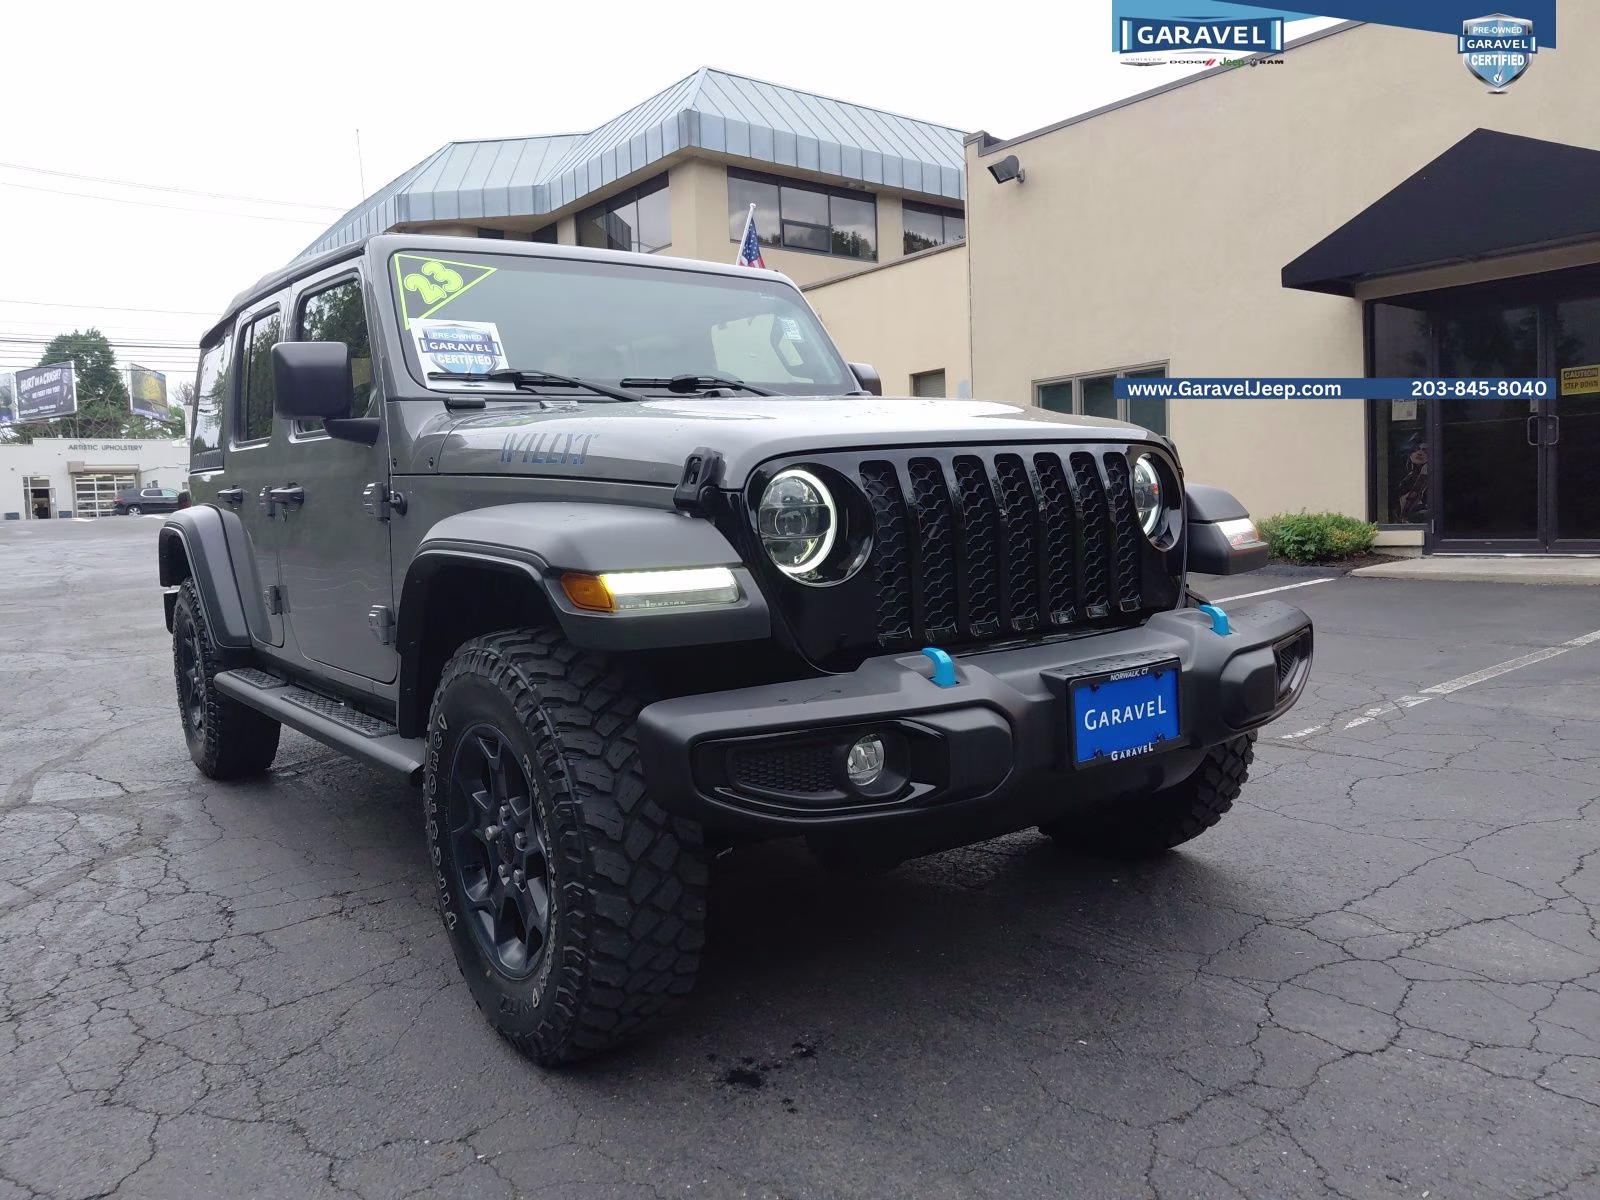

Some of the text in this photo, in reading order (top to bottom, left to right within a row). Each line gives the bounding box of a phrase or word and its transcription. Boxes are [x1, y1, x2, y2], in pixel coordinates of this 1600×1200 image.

[404, 261, 464, 305] 23
[432, 332, 483, 341] PRE-OWNED
[429, 341, 492, 353] GARAVEL
[437, 355, 492, 365] CERTIFIED
[1564, 369, 1598, 379] CAUTION
[1564, 380, 1598, 390] STEP DOWN
[1141, 667, 1149, 676] CT
[1084, 695, 1167, 731] GARAVEL
[1111, 742, 1154, 761] GARAVEL
